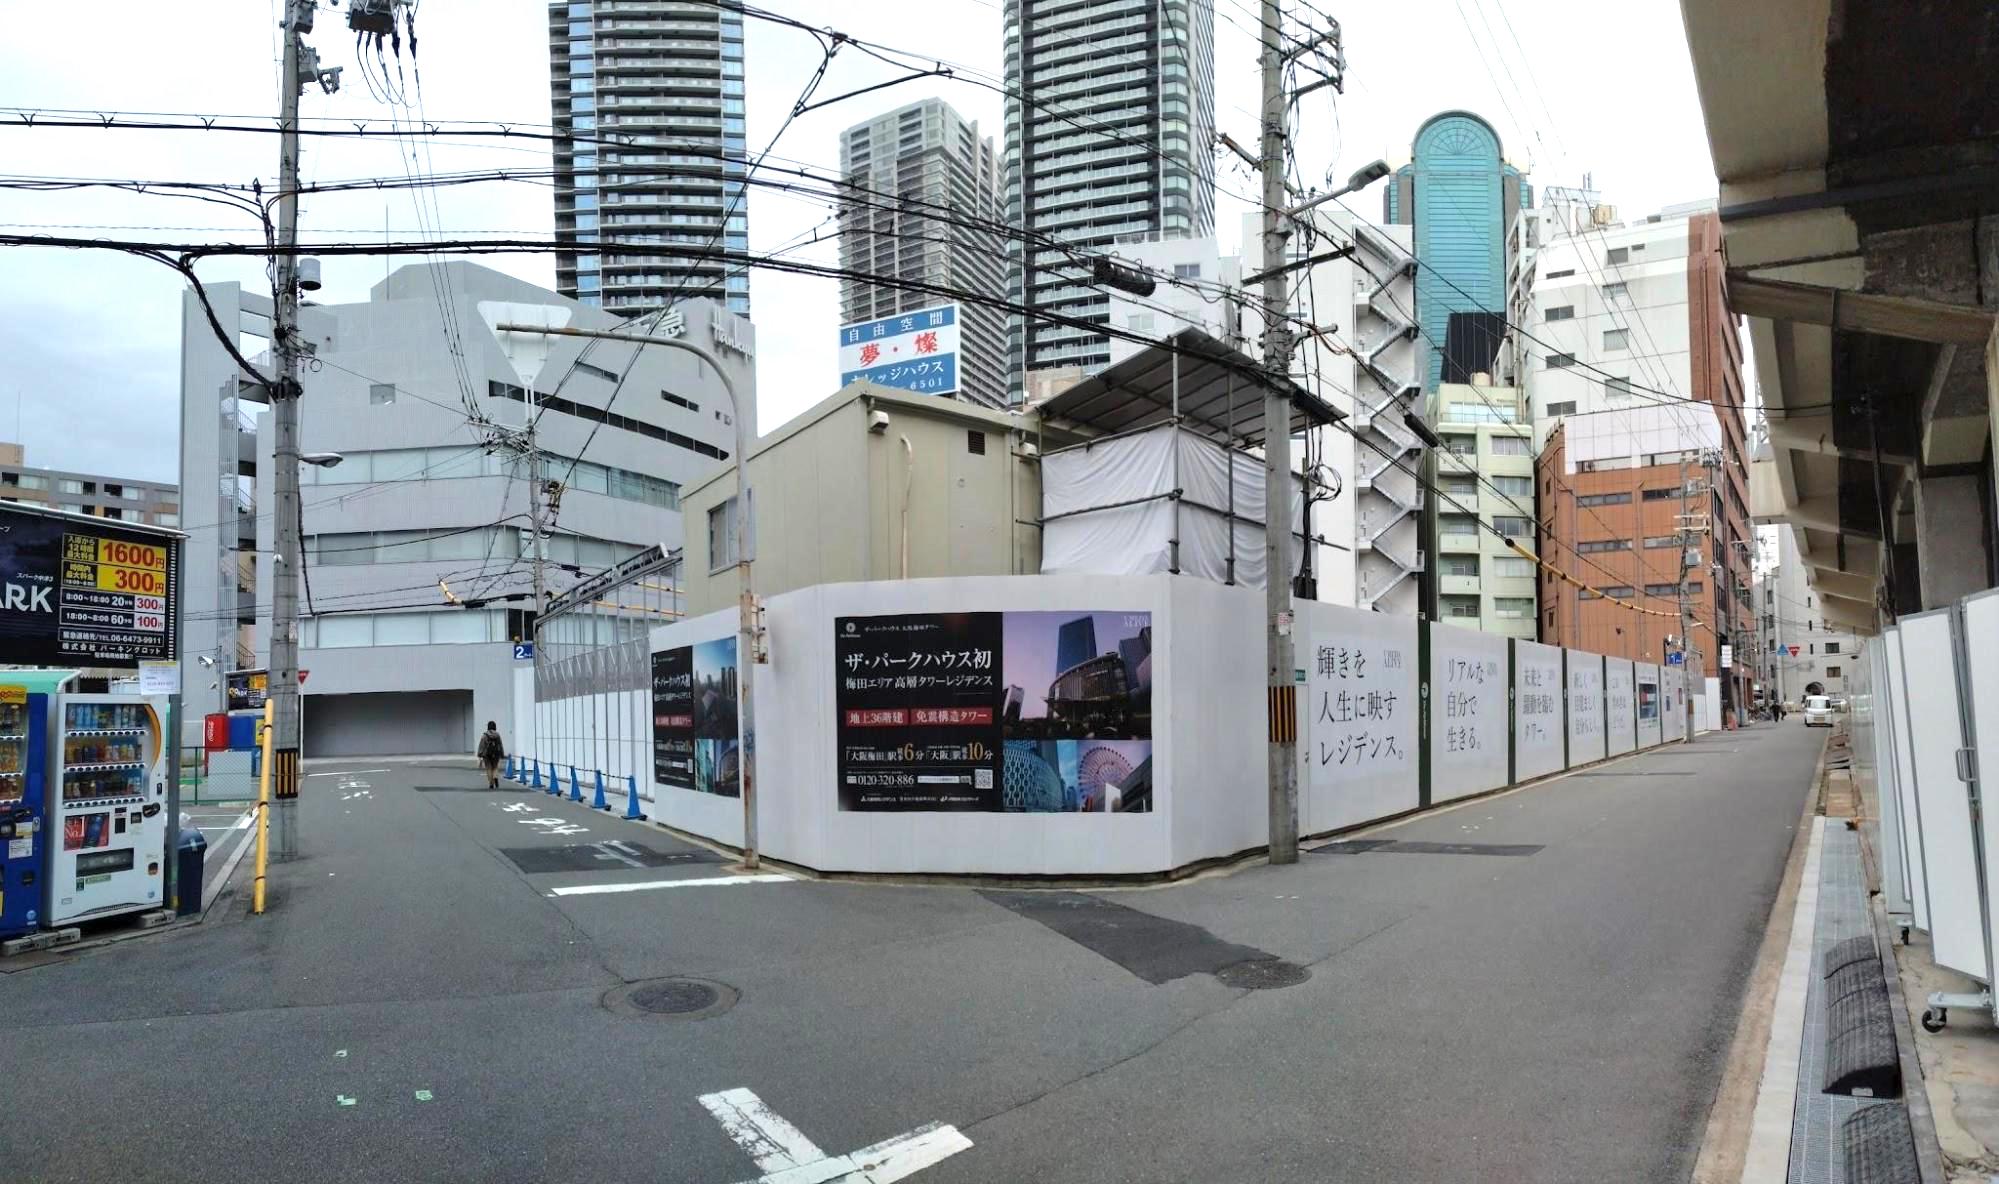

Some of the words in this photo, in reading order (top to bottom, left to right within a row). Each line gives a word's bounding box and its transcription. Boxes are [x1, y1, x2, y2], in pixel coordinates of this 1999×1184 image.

[849, 311, 943, 342] 自由空間
[860, 331, 938, 367] 夢・燦
[104, 541, 165, 569] 1600円
[115, 569, 164, 593] 300円
[0, 581, 54, 613] RK
[136, 597, 163, 611] 300円
[137, 615, 163, 629] 100円
[100, 644, 161, 655] パーキングロット
[844, 648, 992, 672] ザ・パークハウス初
[1317, 645, 1366, 680] 輝きを
[1449, 658, 1484, 684] リアルな
[849, 711, 904, 724] 地上36階建
[916, 710, 988, 723] 免震構造タワー
[1318, 689, 1397, 724] 人生に映す
[1447, 691, 1478, 718] 自分で
[1320, 731, 1403, 766] レジデンス。
